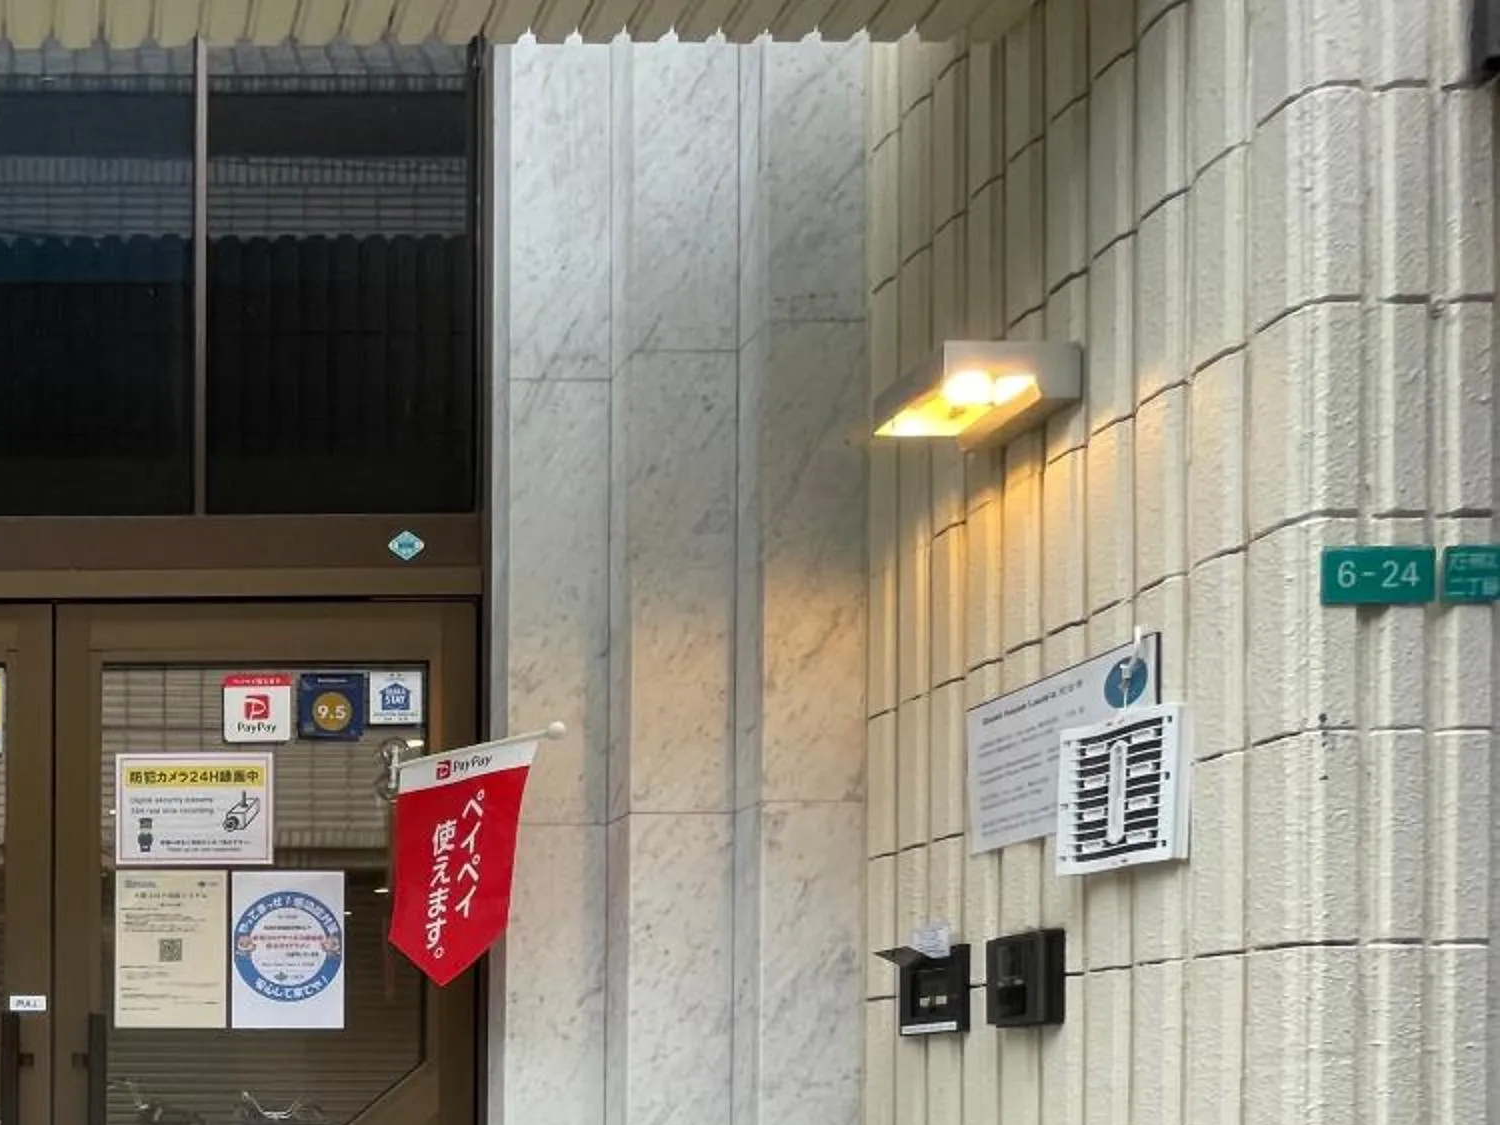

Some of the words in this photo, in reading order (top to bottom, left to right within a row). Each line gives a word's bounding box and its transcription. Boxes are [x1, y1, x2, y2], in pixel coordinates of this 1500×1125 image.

[1337, 560, 1421, 588] 6-24
[317, 703, 346, 720] 9.5
[237, 721, 277, 734] PayPay
[452, 755, 493, 773] PayPay
[455, 788, 485, 919] ペイペイ
[426, 819, 457, 959] 使えます。
